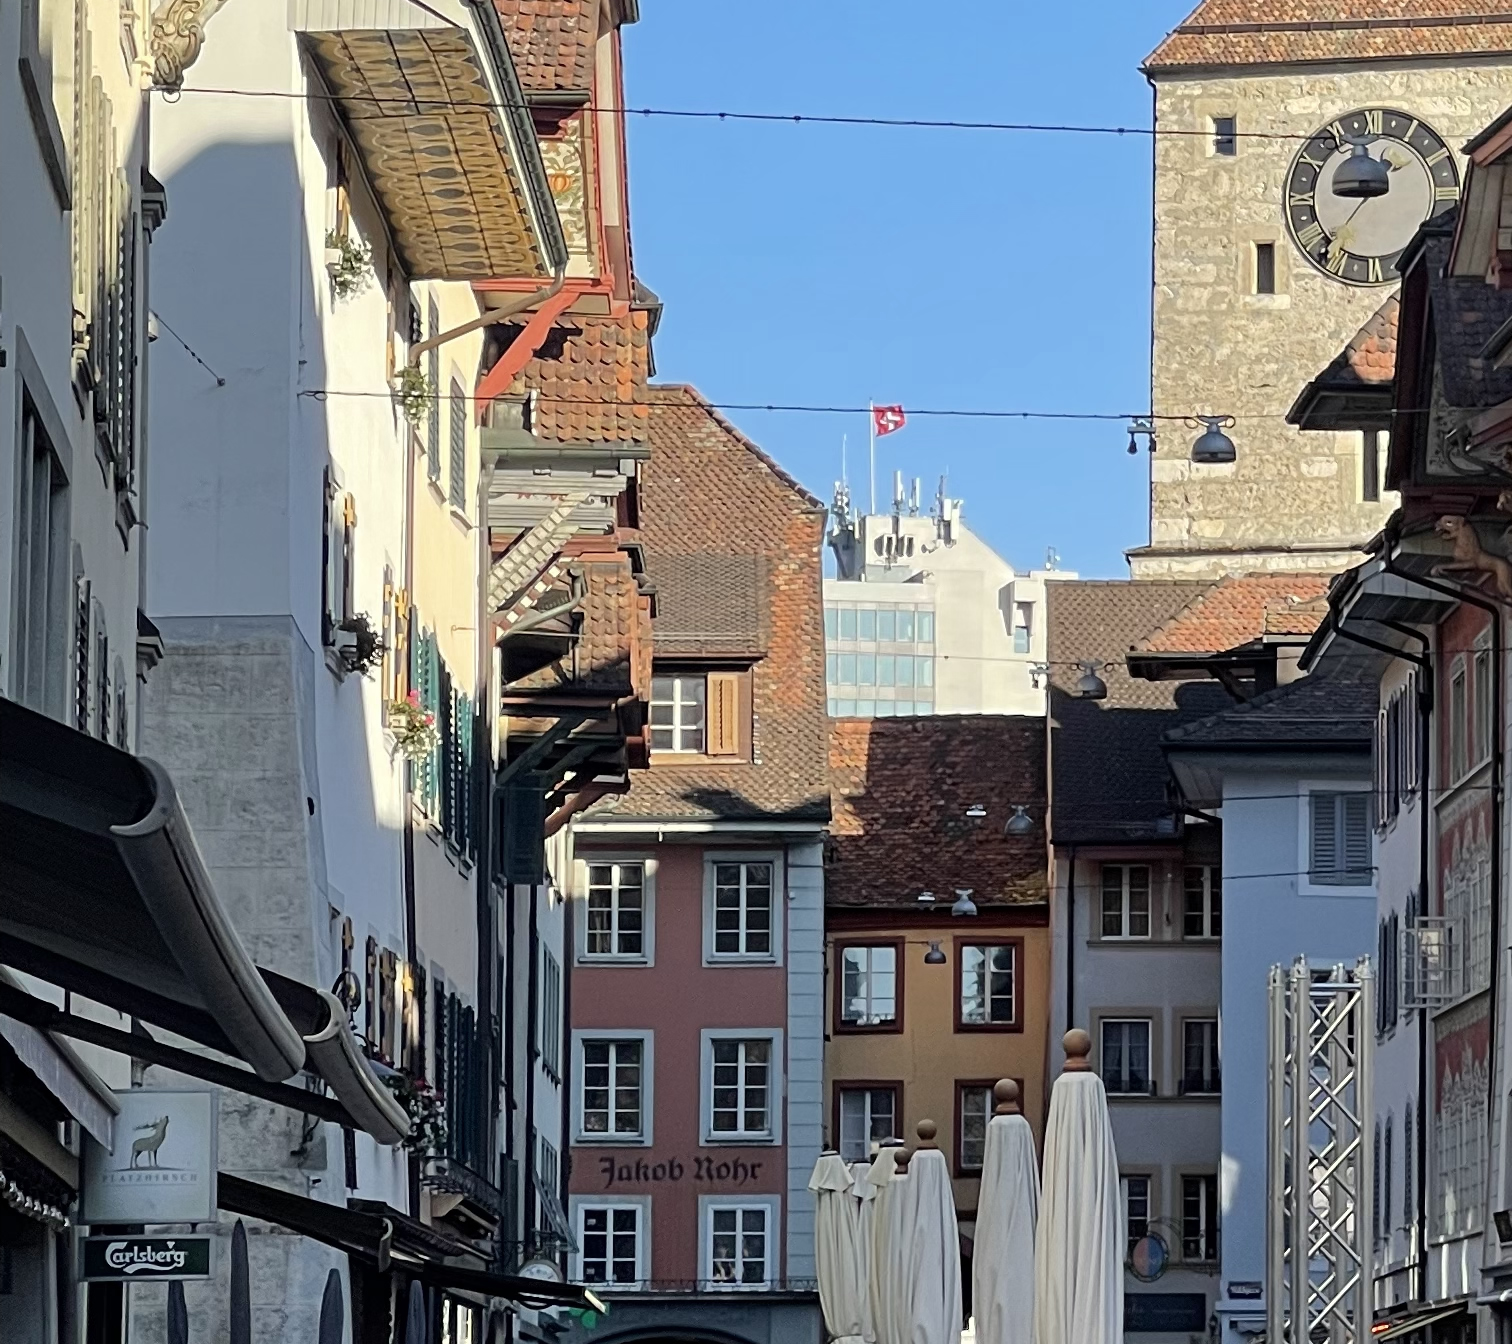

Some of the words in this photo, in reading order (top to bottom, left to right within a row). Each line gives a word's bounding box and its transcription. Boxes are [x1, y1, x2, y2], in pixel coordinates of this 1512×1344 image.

[102, 1172, 198, 1183] PLATZHIRSCH
[599, 1156, 684, 1189] Jakob
[693, 1156, 763, 1186] Rohr
[105, 1241, 188, 1274] Carlsberg
